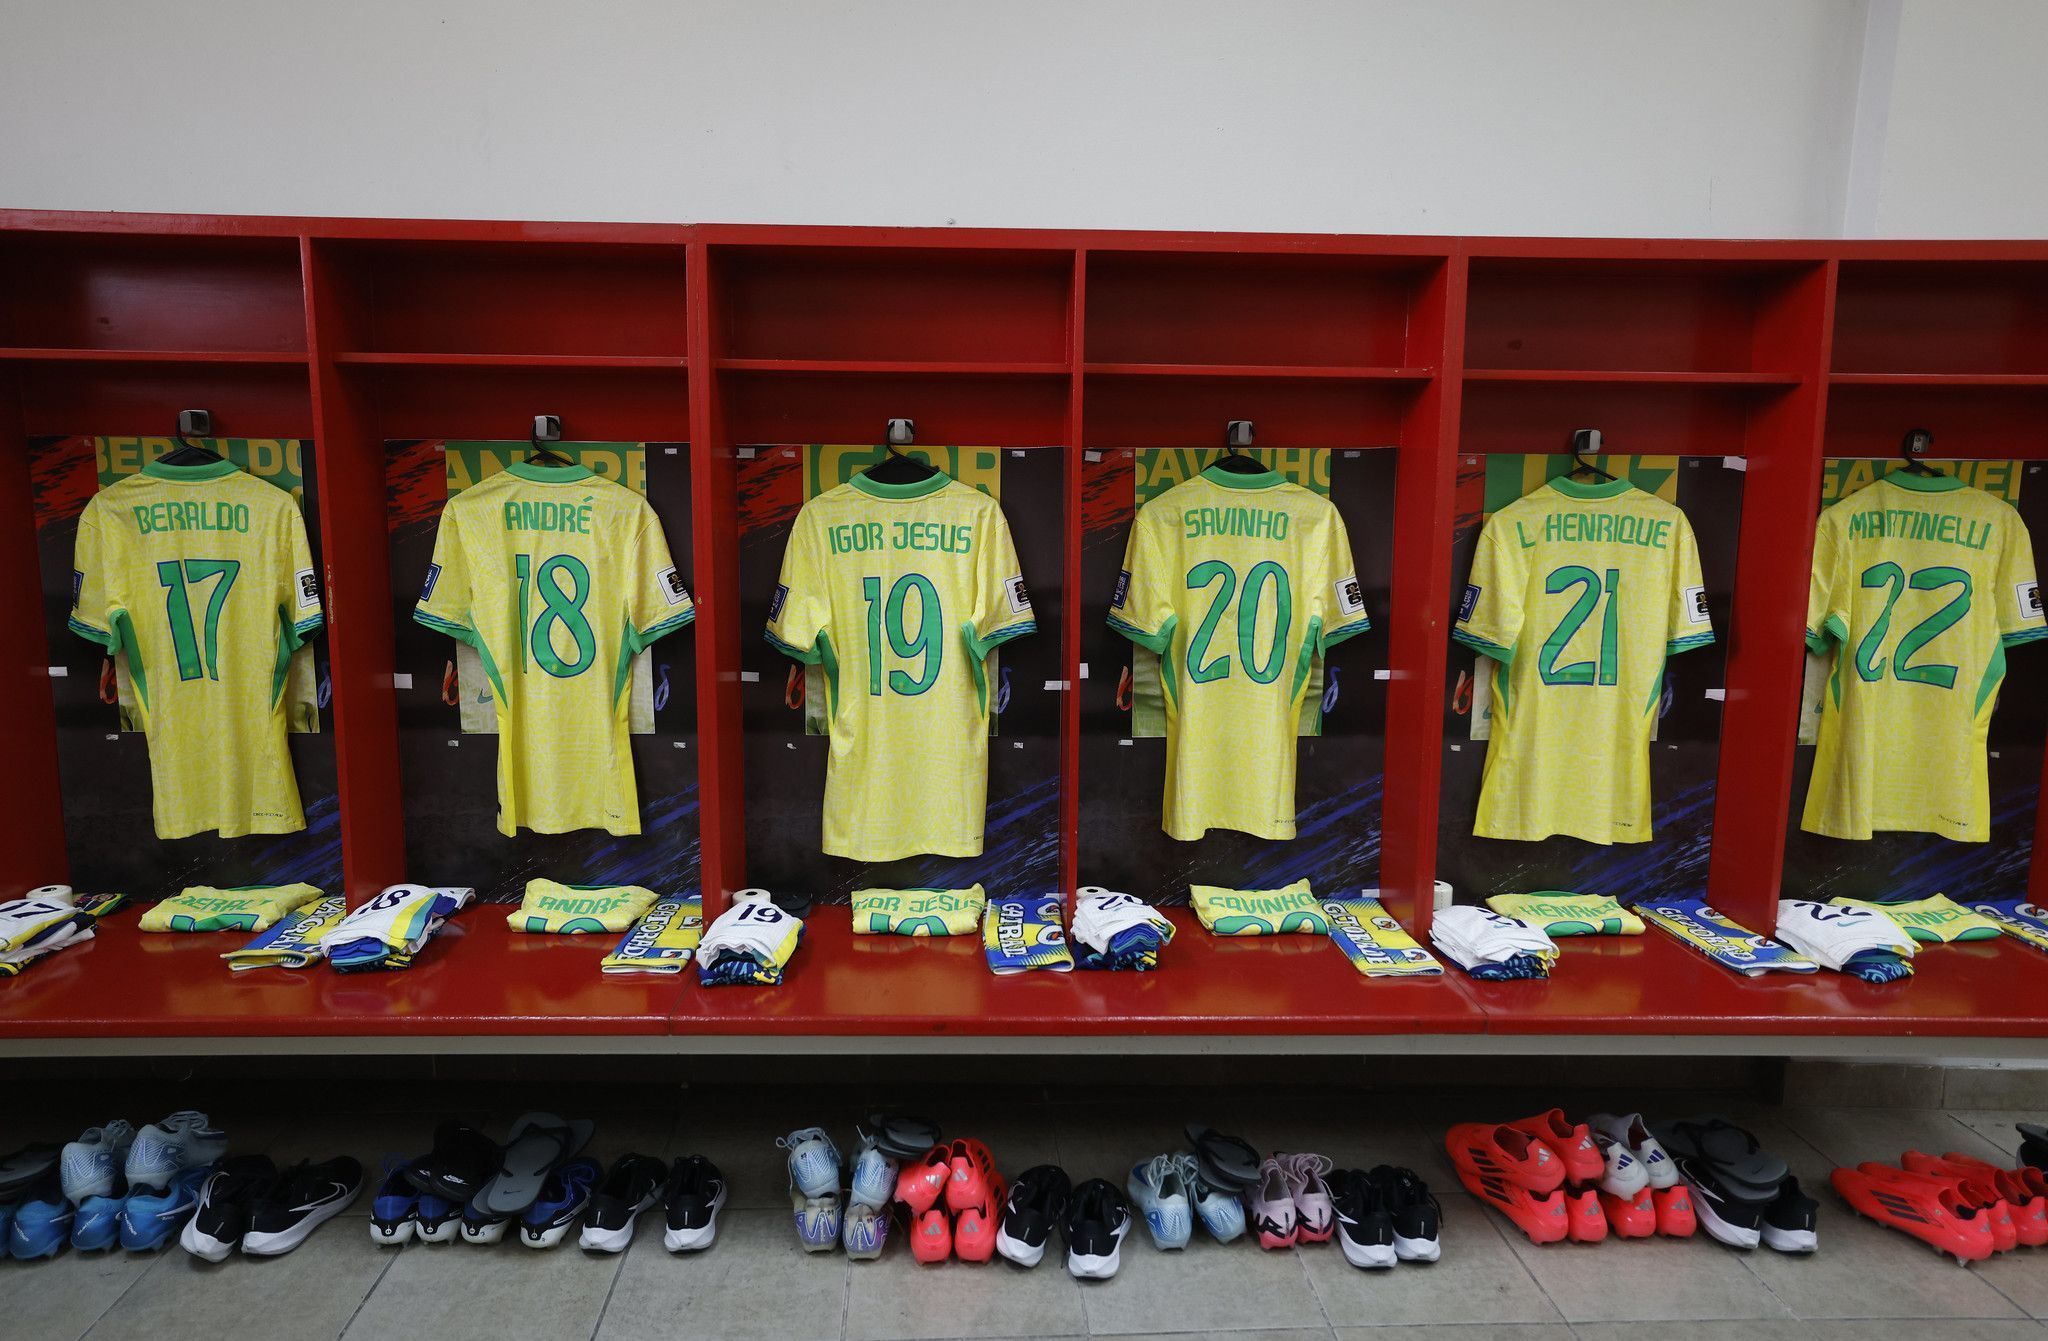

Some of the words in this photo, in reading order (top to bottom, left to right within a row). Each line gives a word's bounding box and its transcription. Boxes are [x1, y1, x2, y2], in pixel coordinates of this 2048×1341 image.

[133, 501, 249, 535] BERALDO
[504, 495, 594, 535] ANDRÉ
[828, 522, 884, 555] IGOR
[893, 521, 972, 555] JESUS
[1184, 507, 1289, 541] SAVINHO
[1545, 513, 1671, 549] HENRIQUE
[157, 559, 241, 682] 17
[515, 554, 597, 678] 18
[863, 573, 943, 696] 19
[1187, 560, 1292, 684] 20
[1538, 565, 1620, 686] 21
[1855, 561, 1973, 690] 22
[738, 903, 784, 924] 19
